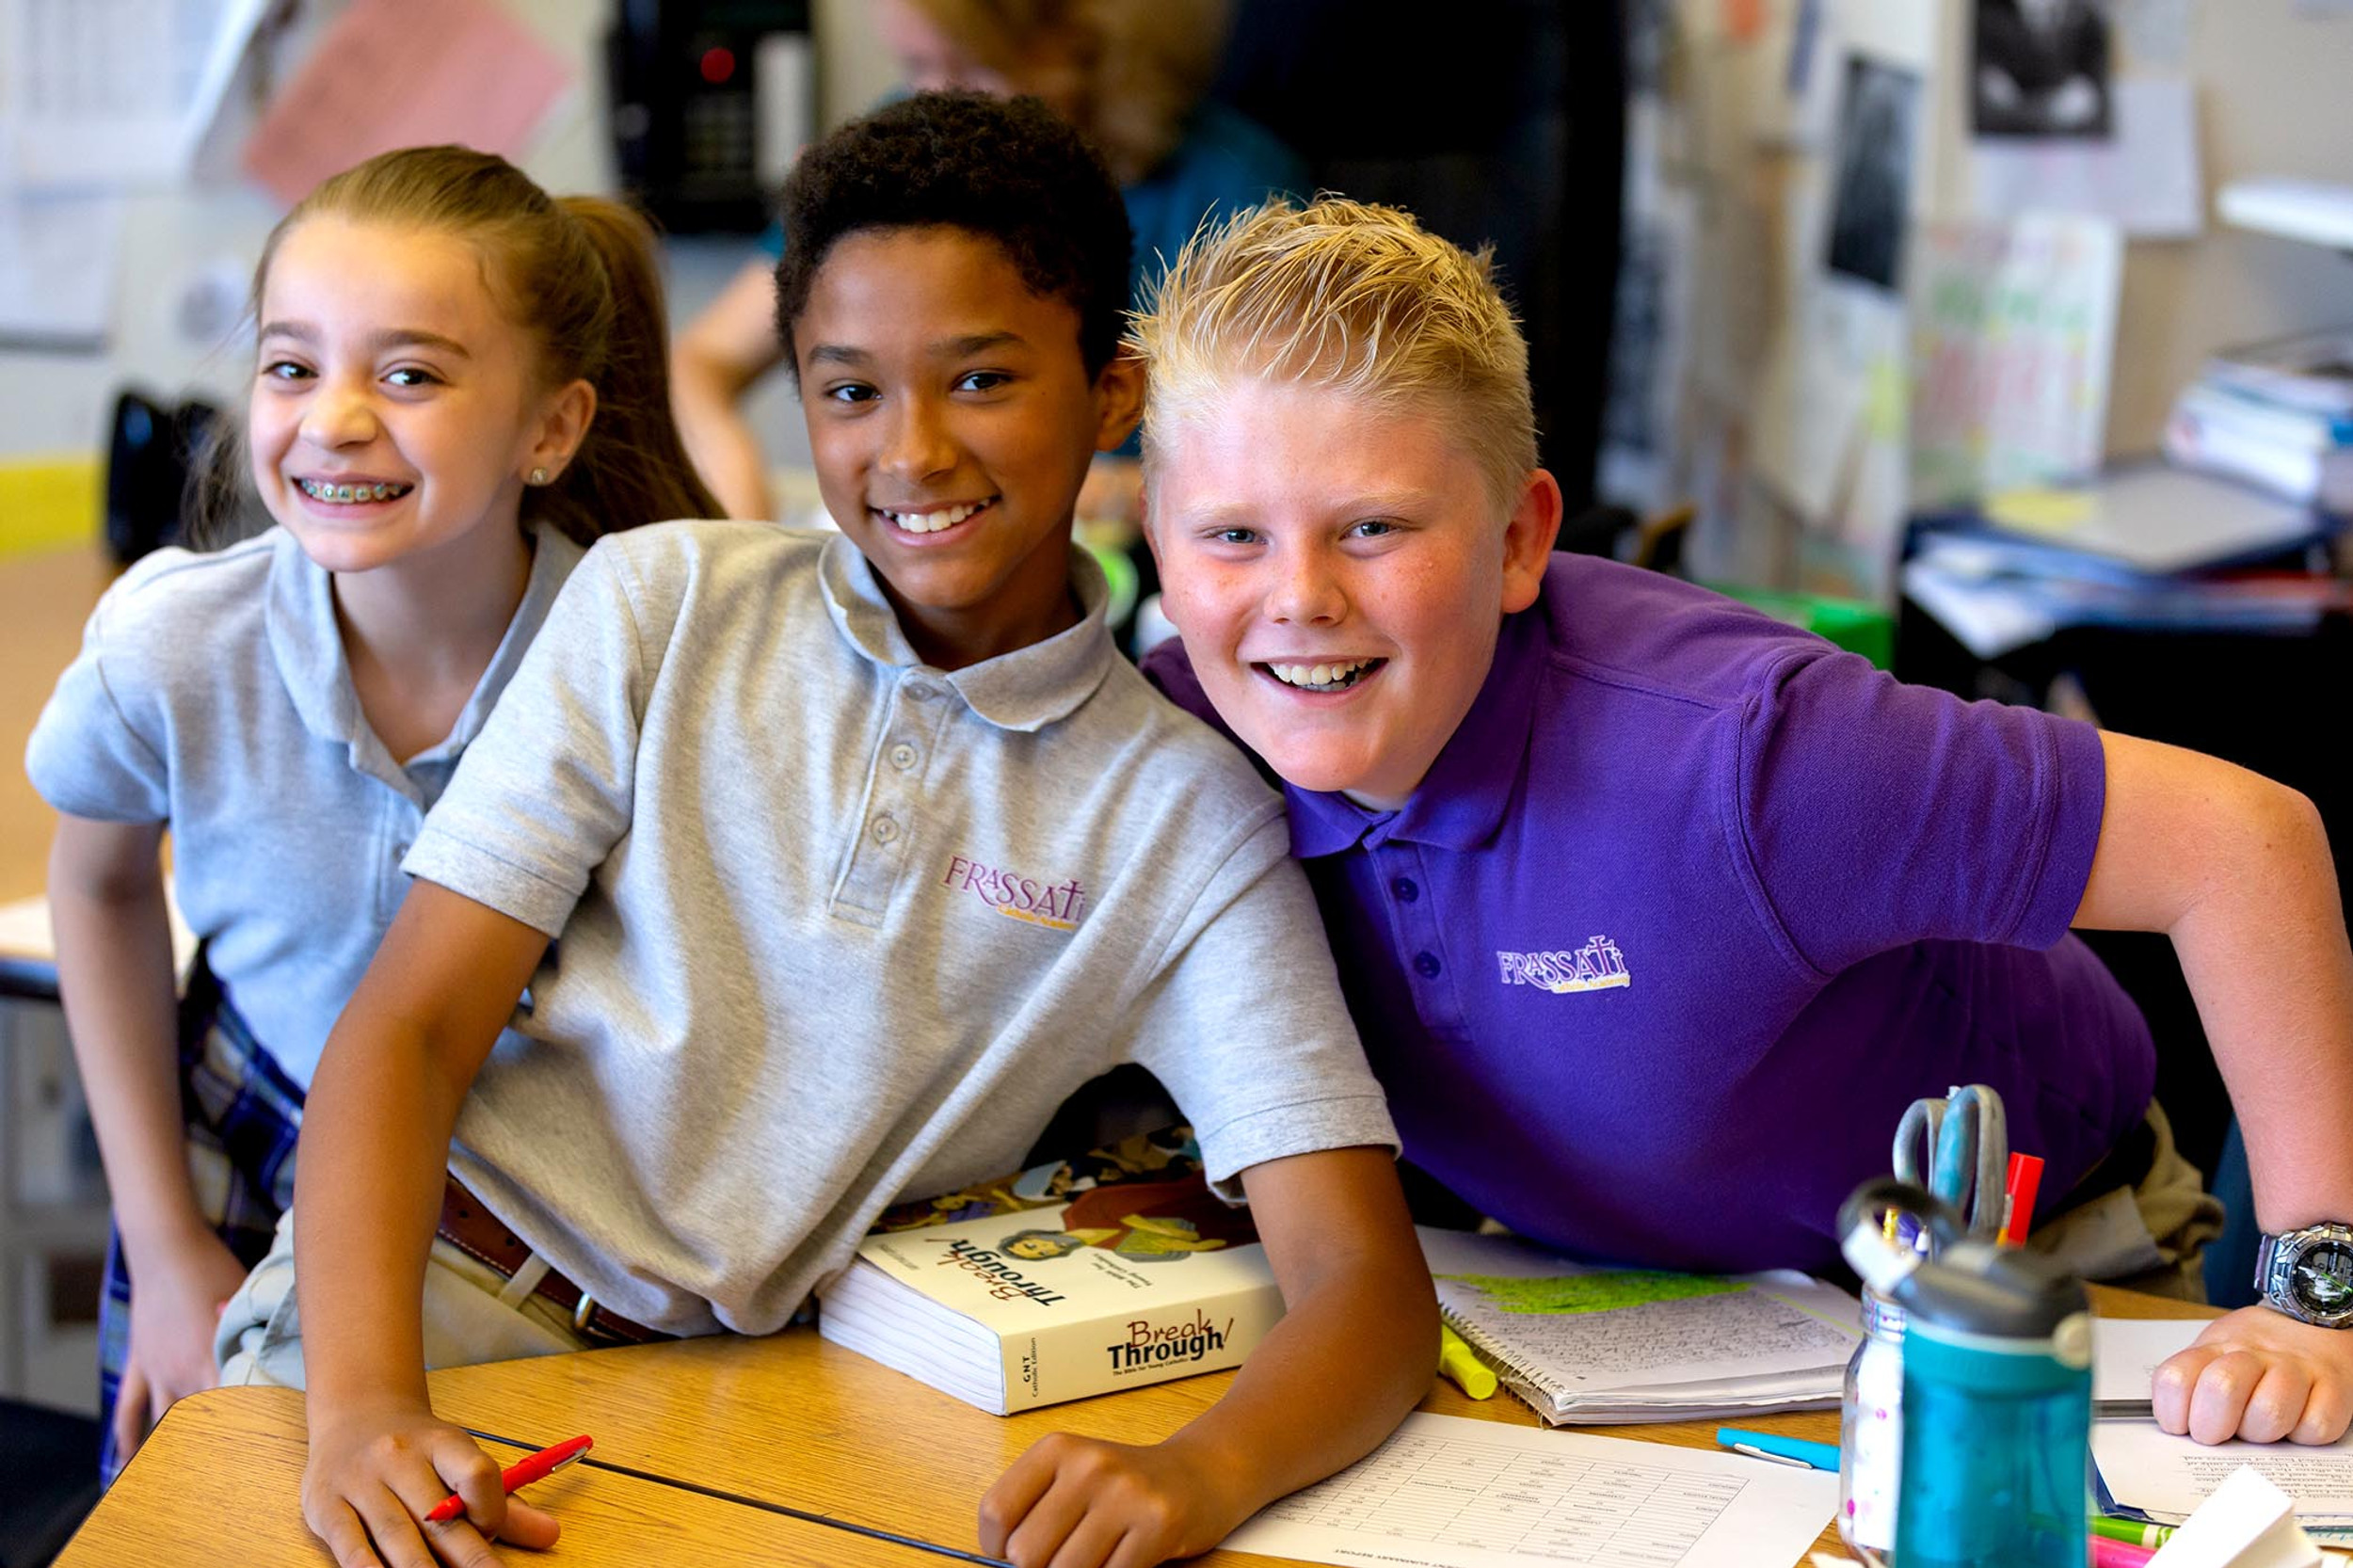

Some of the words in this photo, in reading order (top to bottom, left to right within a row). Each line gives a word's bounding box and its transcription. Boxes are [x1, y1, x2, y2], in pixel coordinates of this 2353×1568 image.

[936, 1249, 1032, 1302] Break
[1127, 1308, 1212, 1348] Break
[1022, 1355, 1031, 1383] GNT
